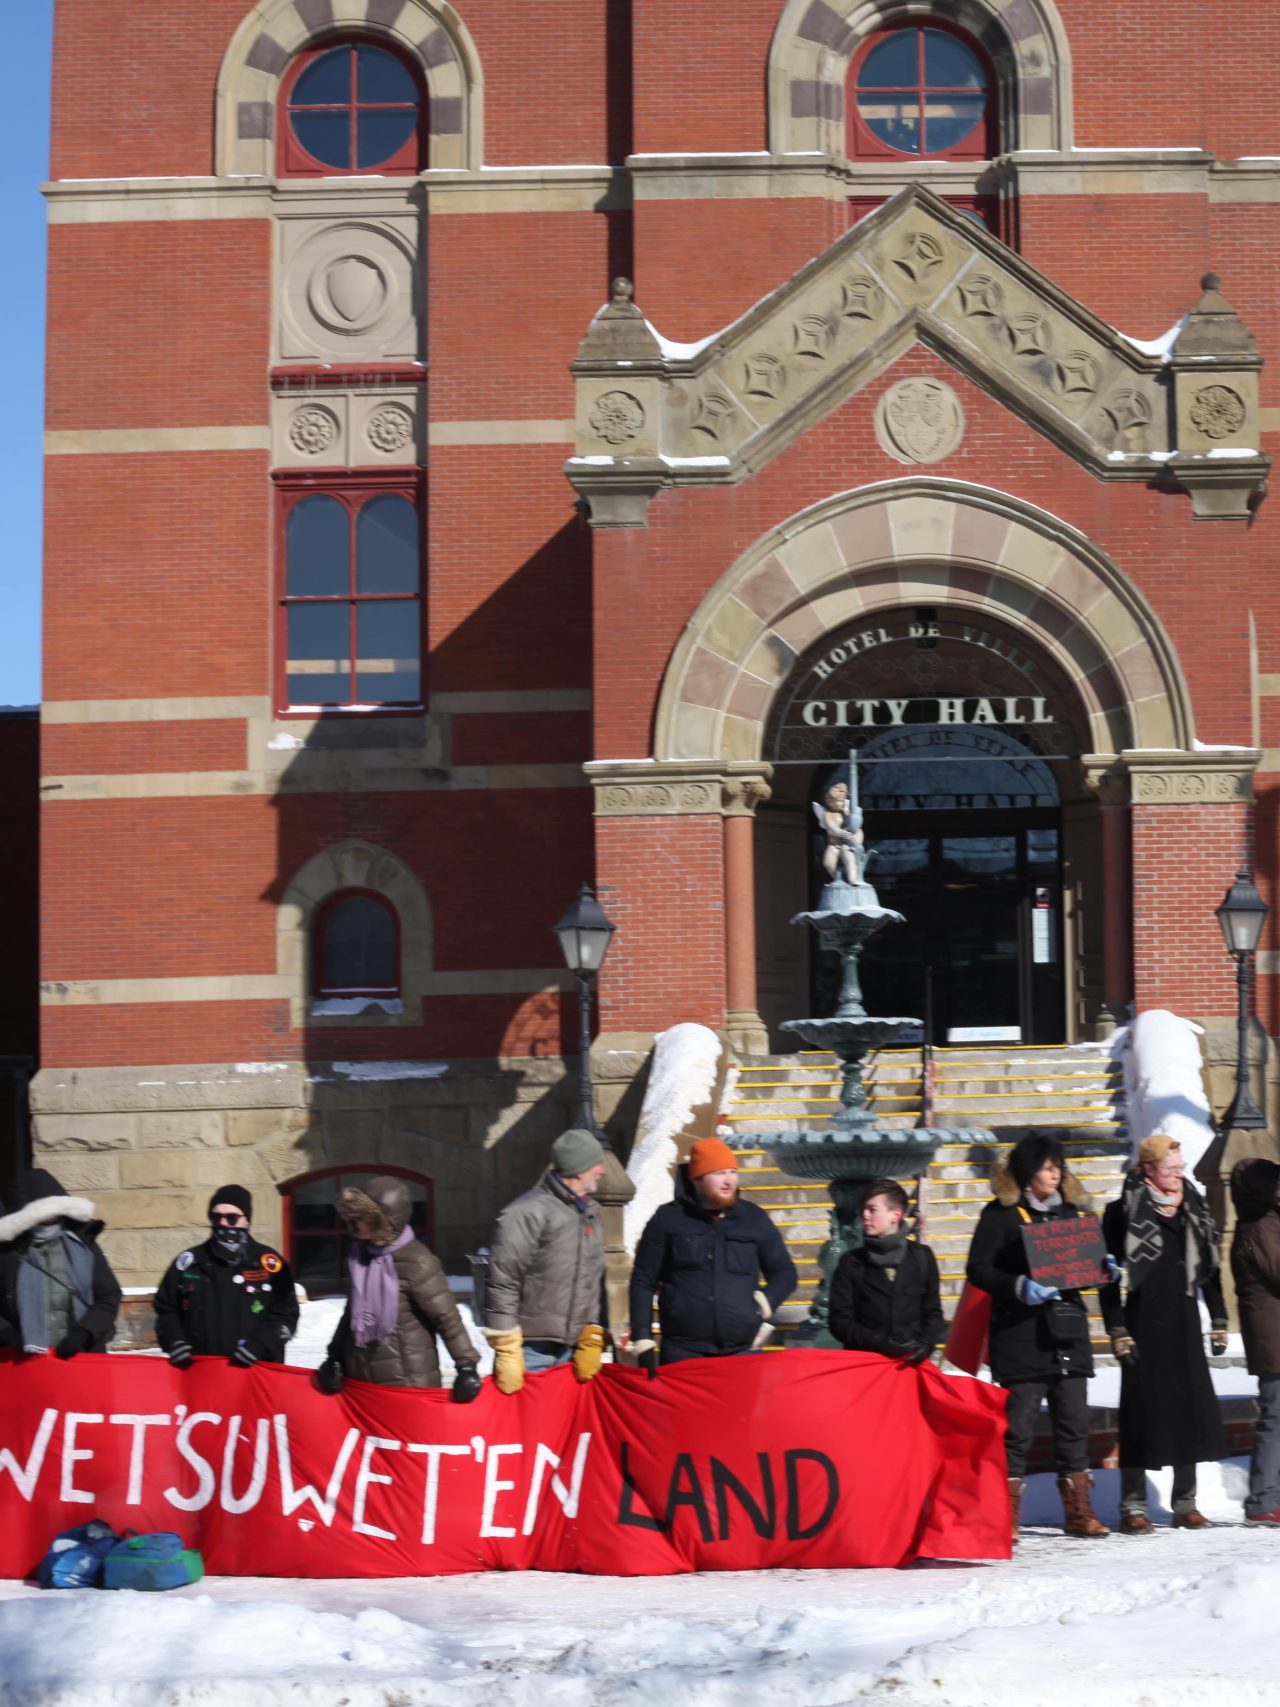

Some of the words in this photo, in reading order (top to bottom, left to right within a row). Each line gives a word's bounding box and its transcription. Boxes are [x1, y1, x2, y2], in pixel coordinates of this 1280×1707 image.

[812, 628, 892, 679] HOTEL
[909, 622, 941, 638] DE
[803, 700, 909, 726] CITY
[937, 698, 1053, 724] HALL
[618, 1442, 840, 1543] LAND
